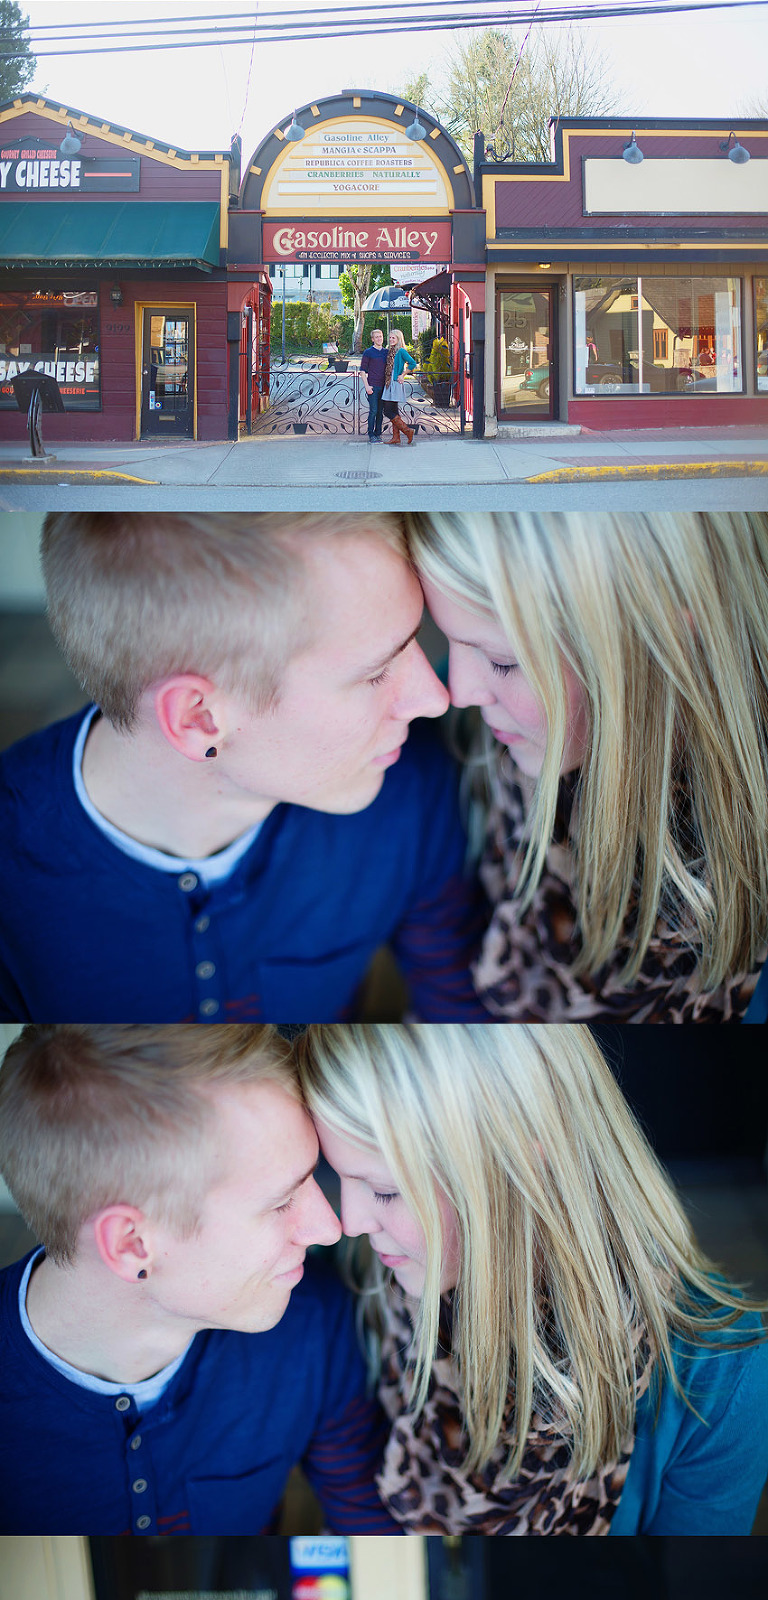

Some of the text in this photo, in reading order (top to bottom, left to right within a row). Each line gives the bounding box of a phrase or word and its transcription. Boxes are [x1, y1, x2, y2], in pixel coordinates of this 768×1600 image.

[323, 134, 389, 143] Gasoline Alley
[322, 146, 356, 154] MANGIA
[363, 146, 397, 154] SCAPPA
[305, 159, 413, 167] REPUBLICA COFFEE ROASTERS
[15, 160, 82, 188] CHEESE
[272, 226, 438, 256] Gasoline Alley
[383, 251, 411, 259] SERVICES
[64, 293, 97, 305] OPEN
[34, 361, 95, 383] CHEESE
